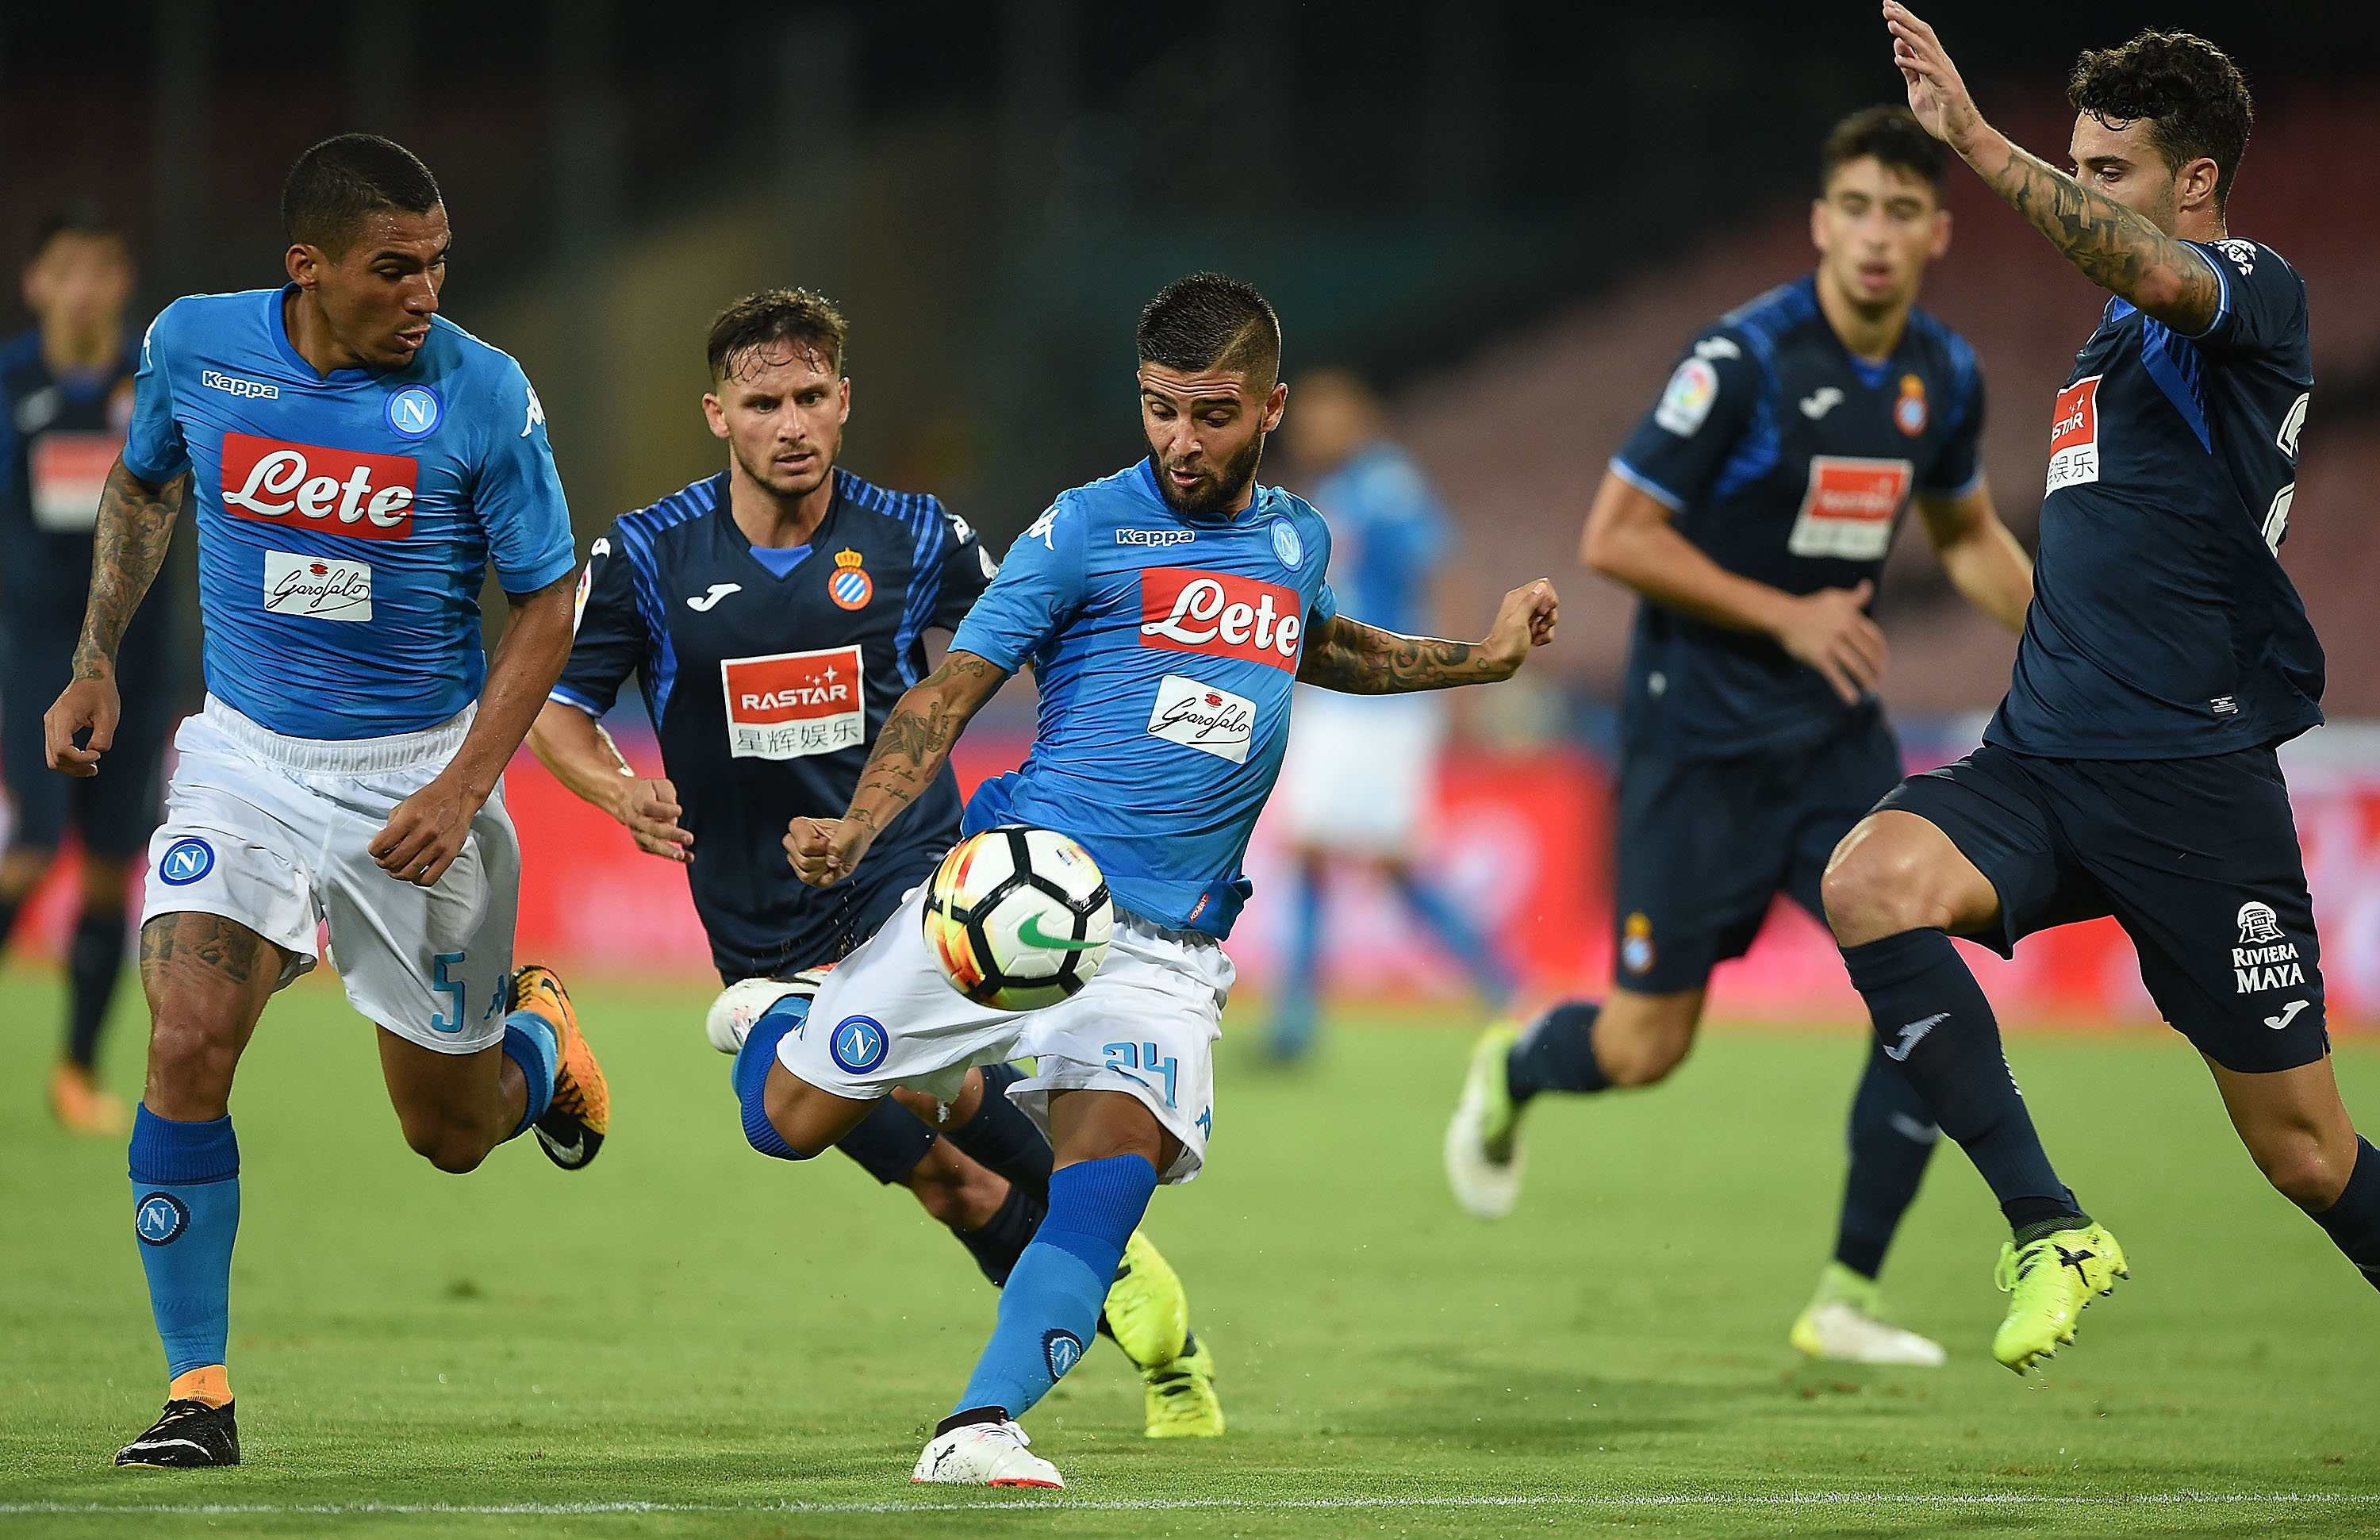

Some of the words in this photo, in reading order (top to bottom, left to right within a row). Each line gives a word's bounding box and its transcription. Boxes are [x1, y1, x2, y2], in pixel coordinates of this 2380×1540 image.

[202, 370, 279, 400] Kappa
[400, 398, 428, 425] N
[221, 450, 413, 528] Lete
[1115, 528, 1196, 547] Kappa
[1279, 531, 1295, 558] N
[266, 568, 370, 614] Garofalo
[1140, 578, 1300, 658] Lete
[741, 684, 847, 711] RASTAR
[1148, 697, 1251, 744] Garofalo
[737, 718, 859, 754] 星辉娱乐
[170, 851, 200, 874] N
[2232, 943, 2300, 967] RIVIERA
[431, 951, 466, 1033] 5
[2233, 962, 2305, 993] MAYA
[841, 1027, 877, 1061] N
[1102, 1041, 1178, 1109] 24
[144, 1207, 167, 1231] N
[1054, 1342, 1076, 1371] N
